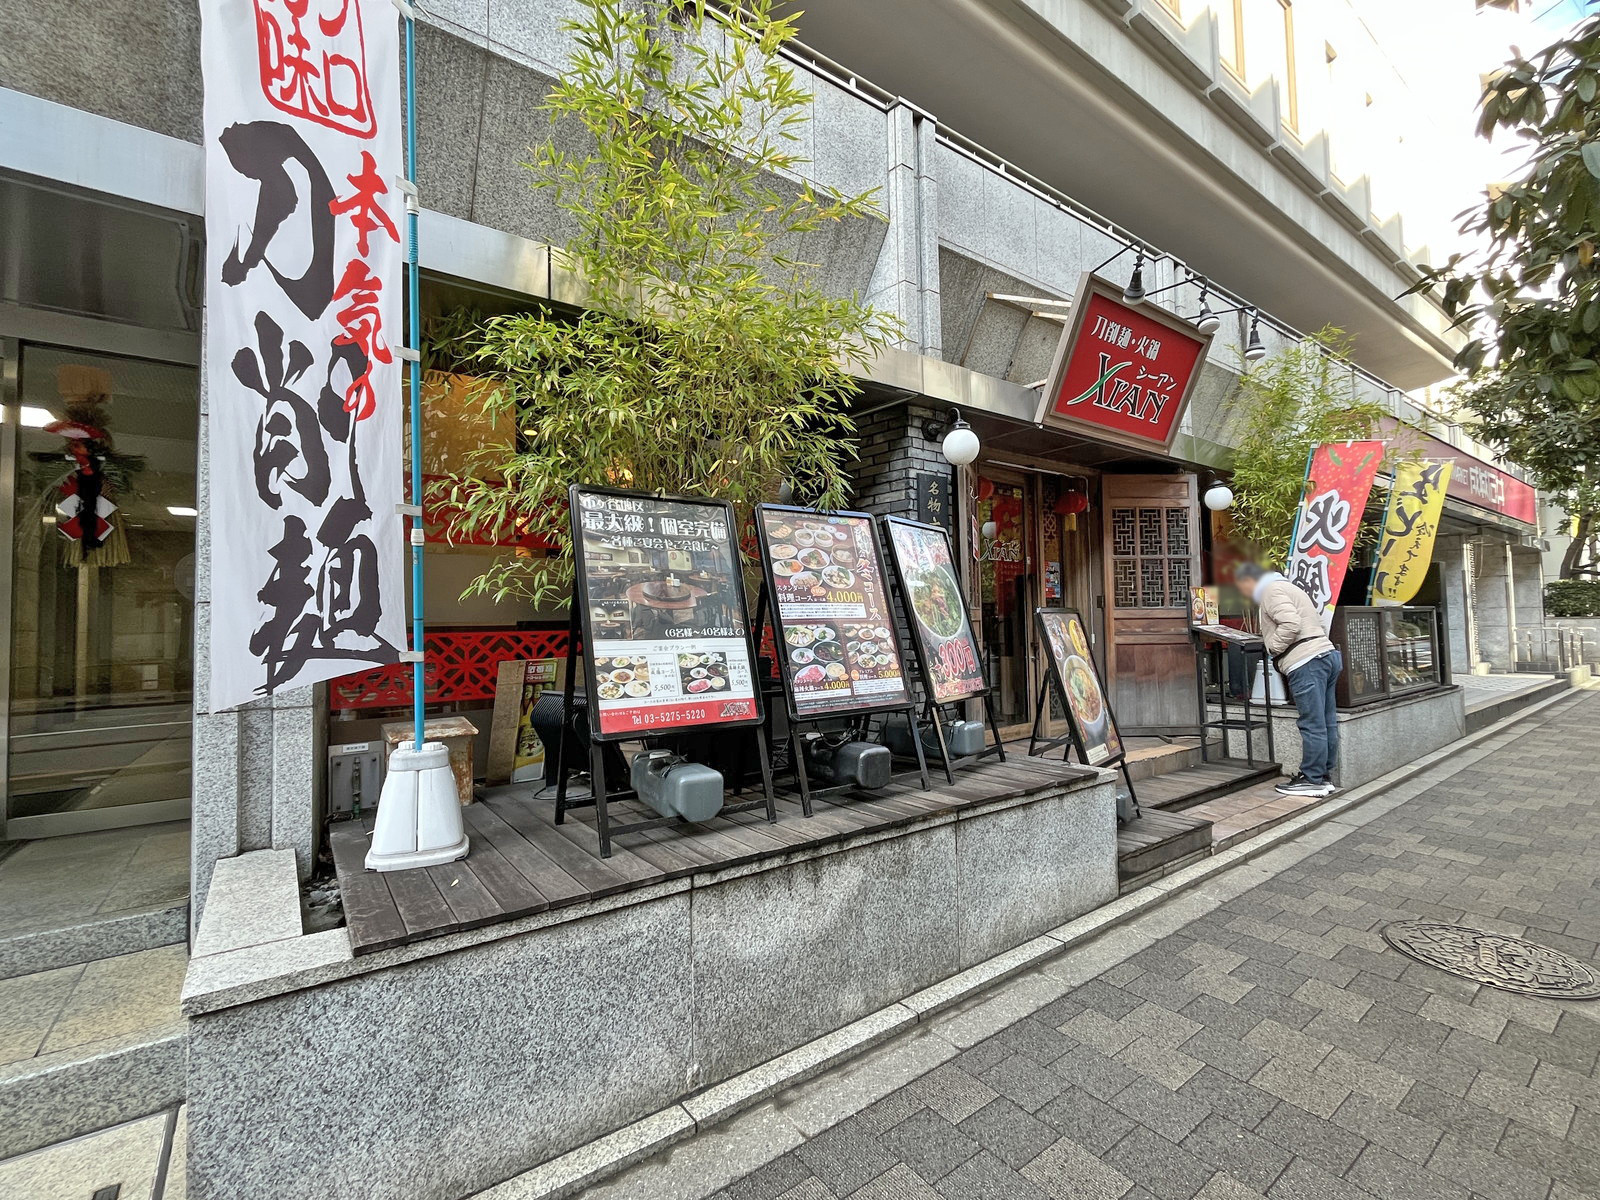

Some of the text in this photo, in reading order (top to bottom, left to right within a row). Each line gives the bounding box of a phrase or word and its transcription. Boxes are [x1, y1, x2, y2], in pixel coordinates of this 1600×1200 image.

[327, 150, 400, 422] 本気の
[1135, 365, 1178, 391] シーアン
[218, 119, 402, 697] 刀削麺
[927, 480, 941, 526] 名物
[632, 715, 642, 726] Tel
[644, 708, 706, 725] 03-5275-5220
